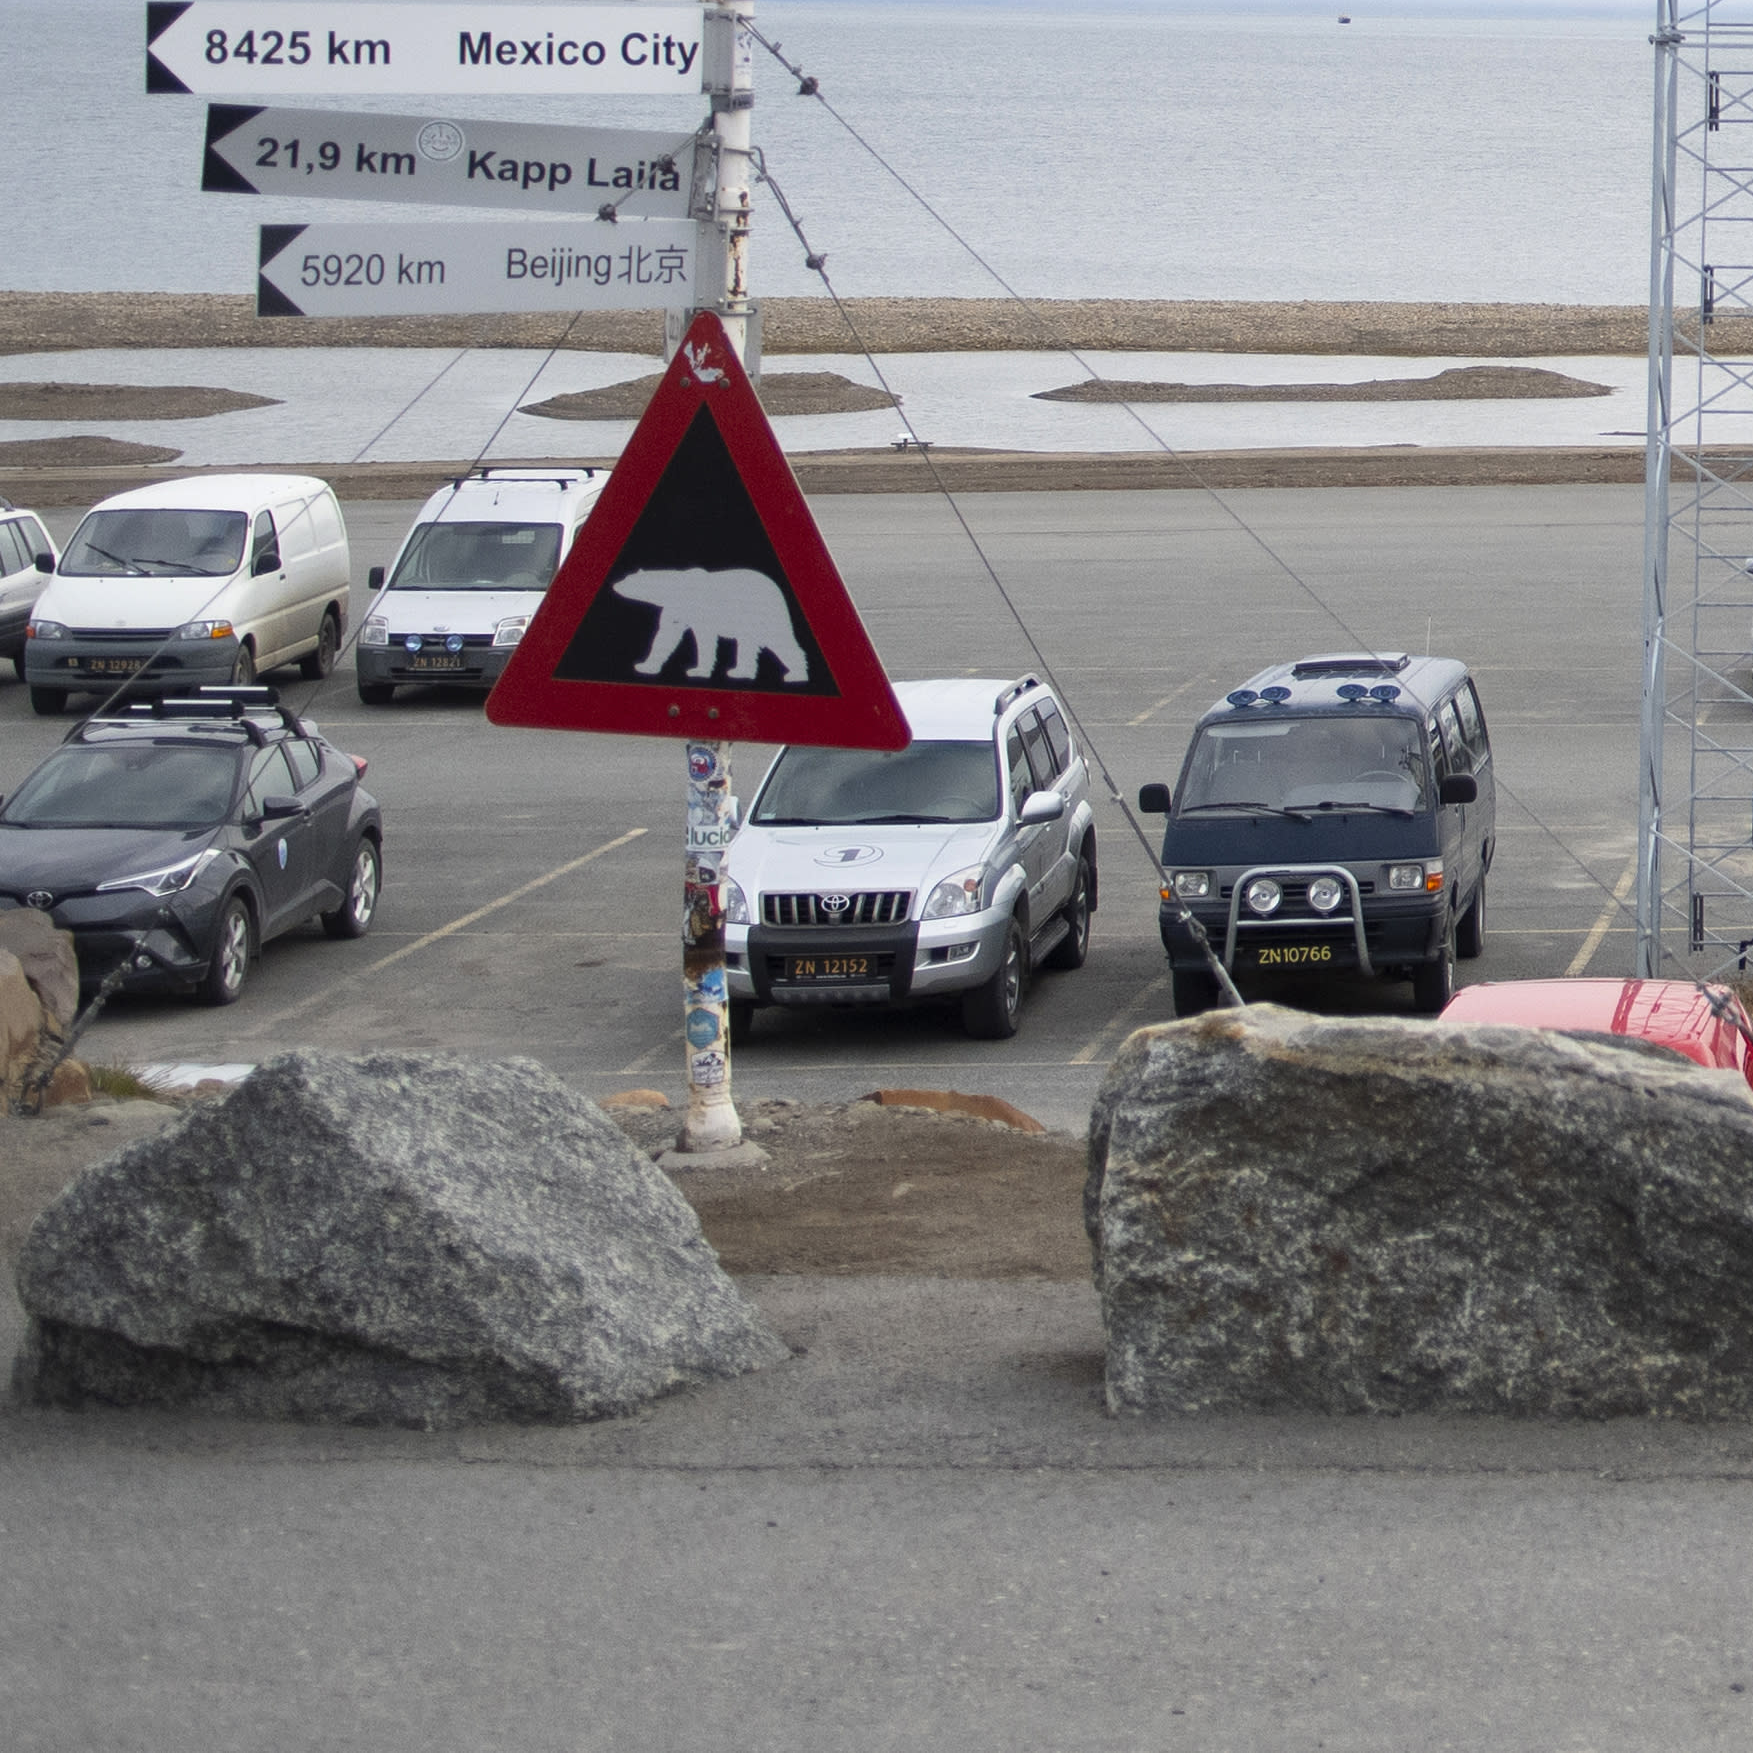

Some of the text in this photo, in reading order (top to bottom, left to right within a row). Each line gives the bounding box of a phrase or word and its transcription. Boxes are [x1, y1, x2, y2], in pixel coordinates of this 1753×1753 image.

[205, 29, 700, 75] 8425 km Mexico City
[256, 137, 680, 192] 21,9 km Kapp Laila
[301, 248, 611, 286] 5920 km Beijing
[617, 244, 689, 285] 北京
[90, 659, 105, 670] ZN
[795, 958, 868, 975] ZN 12152
